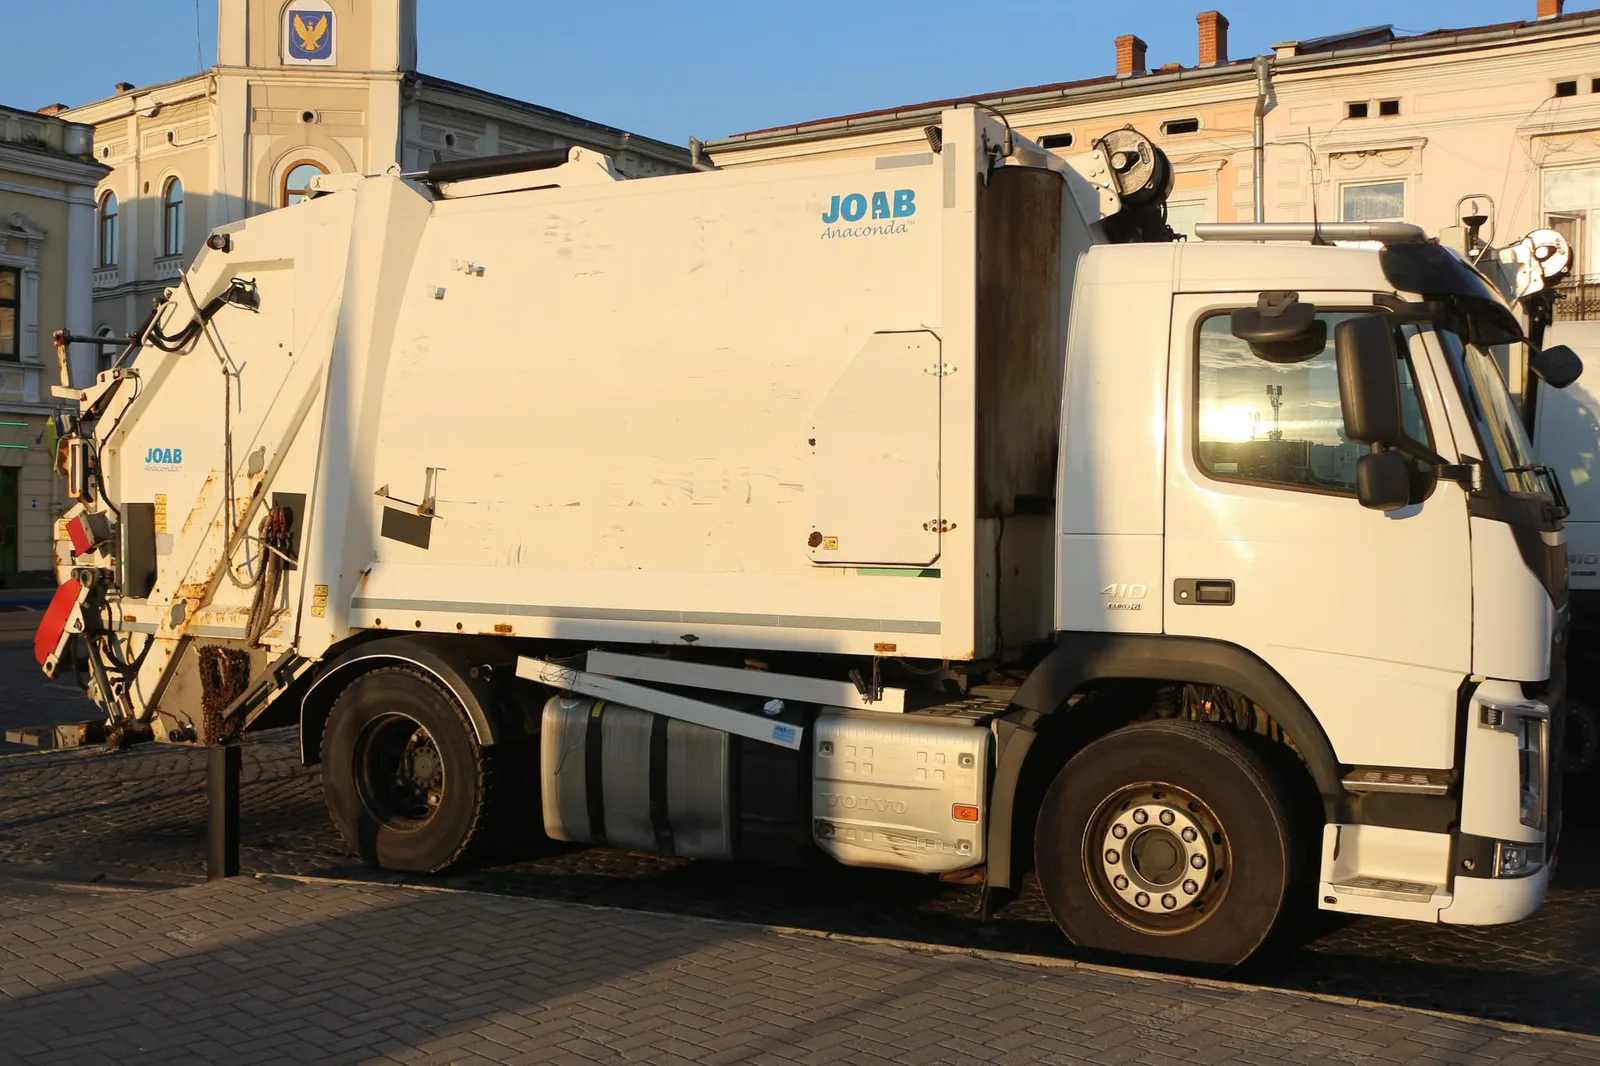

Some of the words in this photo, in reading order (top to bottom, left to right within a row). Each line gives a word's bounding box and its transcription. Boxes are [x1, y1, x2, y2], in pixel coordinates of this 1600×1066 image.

[821, 189, 916, 224] JOAB
[144, 447, 183, 464] JOAB
[1100, 583, 1147, 600] 410
[820, 792, 909, 815] VOLVO
